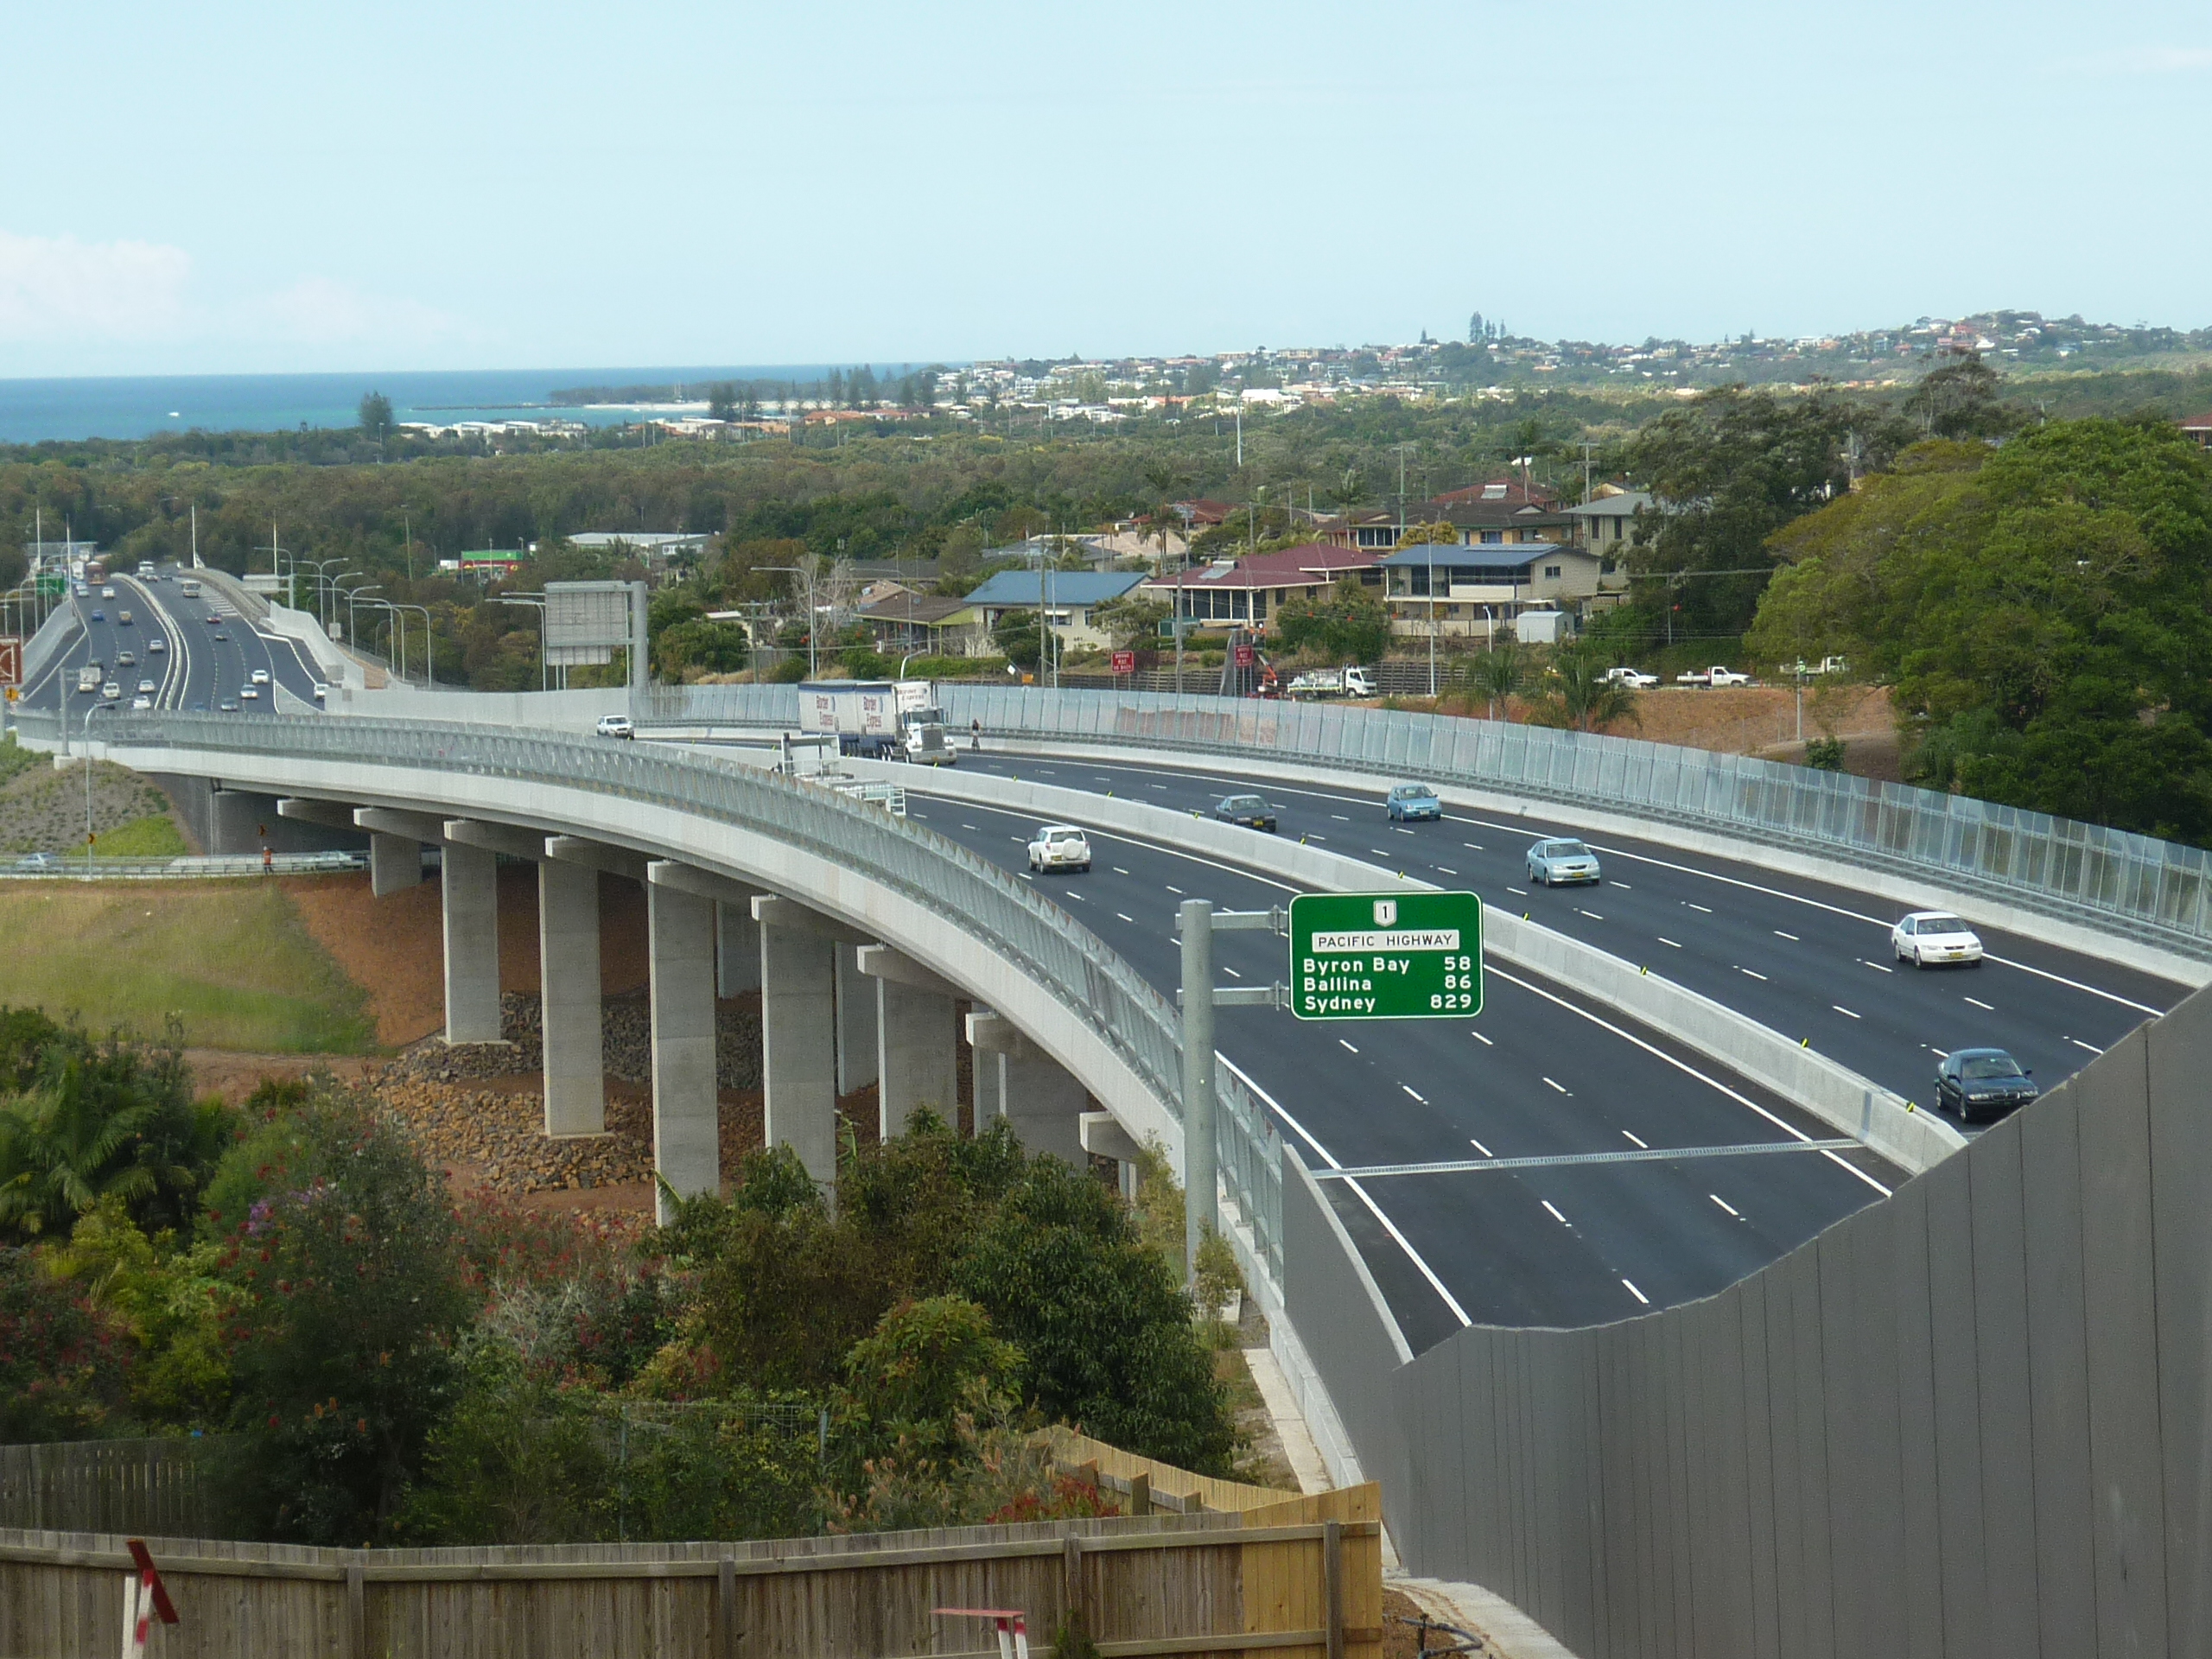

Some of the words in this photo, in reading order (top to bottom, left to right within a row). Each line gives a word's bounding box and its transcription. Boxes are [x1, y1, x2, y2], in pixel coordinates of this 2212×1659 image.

[1382, 906, 1388, 918] 1
[1319, 936, 1375, 948] PACIFIC
[1387, 934, 1452, 946] HIGHWAY
[1303, 958, 1363, 976] Byron
[1373, 957, 1410, 975] Bay
[1444, 956, 1471, 970] 58
[1304, 976, 1372, 991] Ballina
[1445, 975, 1471, 989] 86
[1305, 995, 1376, 1014] Sydney
[1430, 994, 1471, 1009] 829
